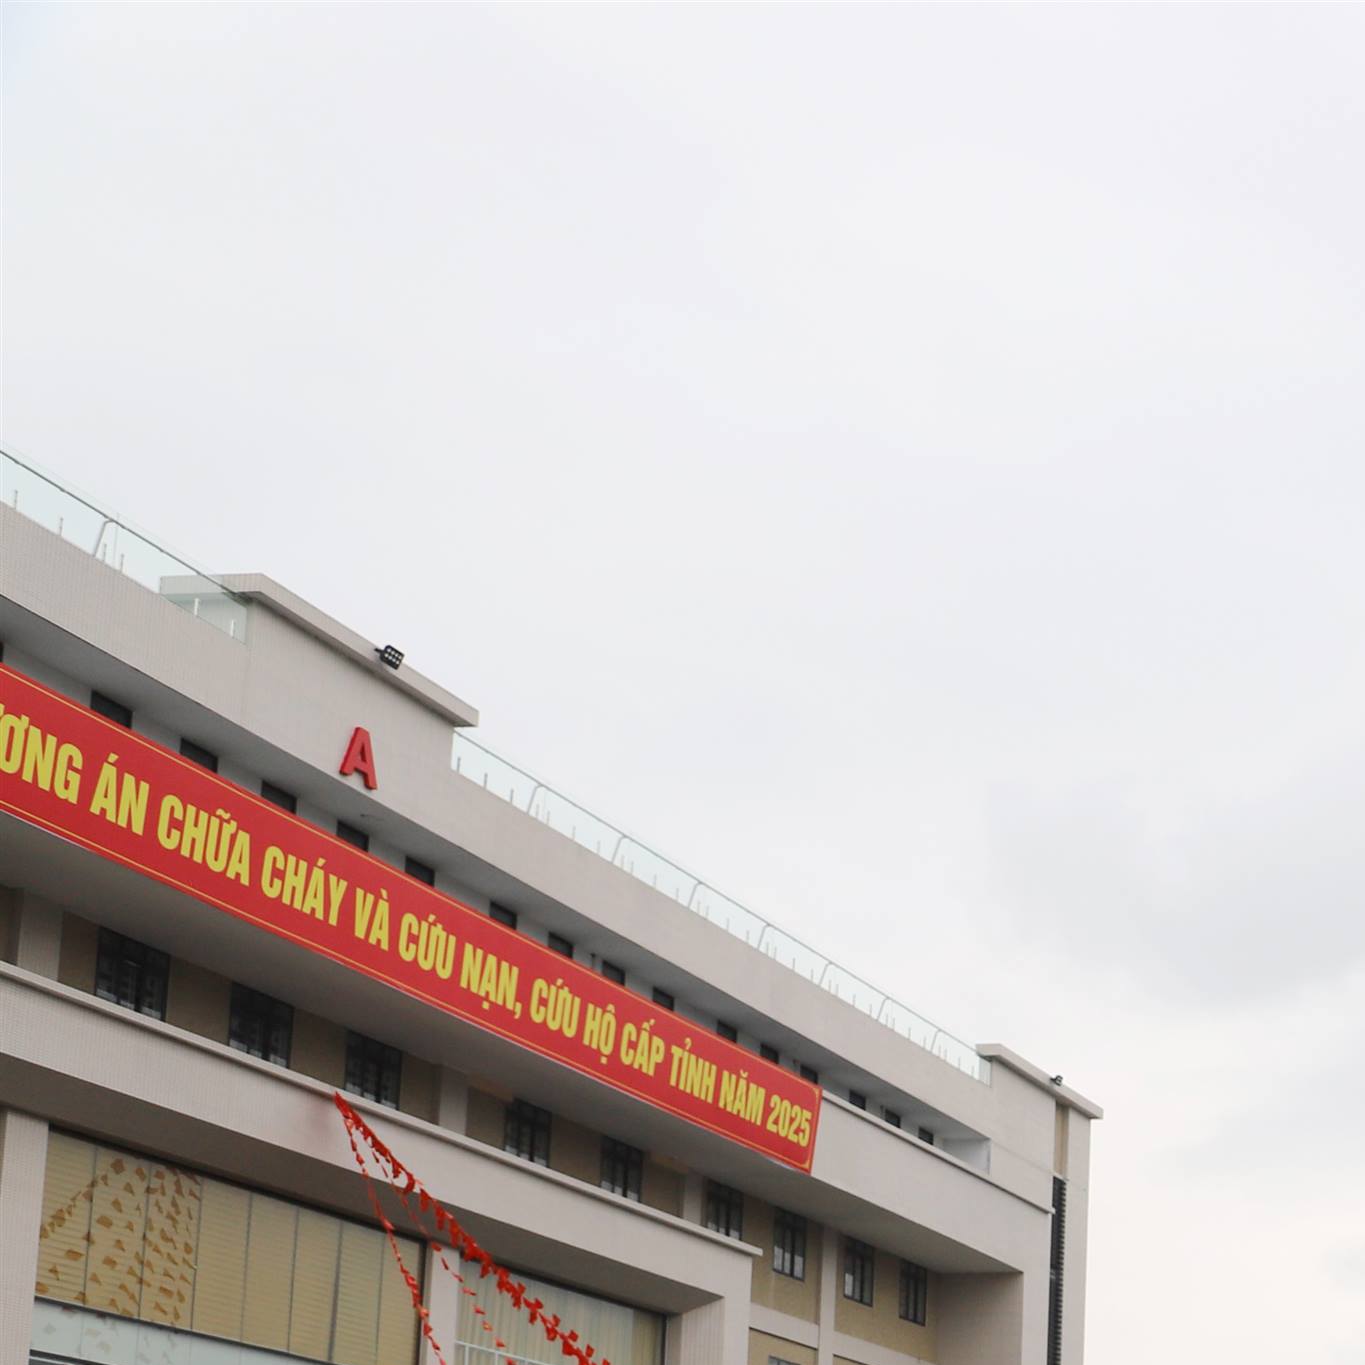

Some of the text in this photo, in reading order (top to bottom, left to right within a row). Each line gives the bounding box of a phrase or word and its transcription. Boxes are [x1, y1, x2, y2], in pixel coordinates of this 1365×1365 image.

[339, 727, 377, 790] A
[0, 703, 812, 1148] ƠNG ÁN CHỮA CHÁY VÀ CỨU NẠN, CỨU HỘ CẤP TỈNH NĂM 2025
